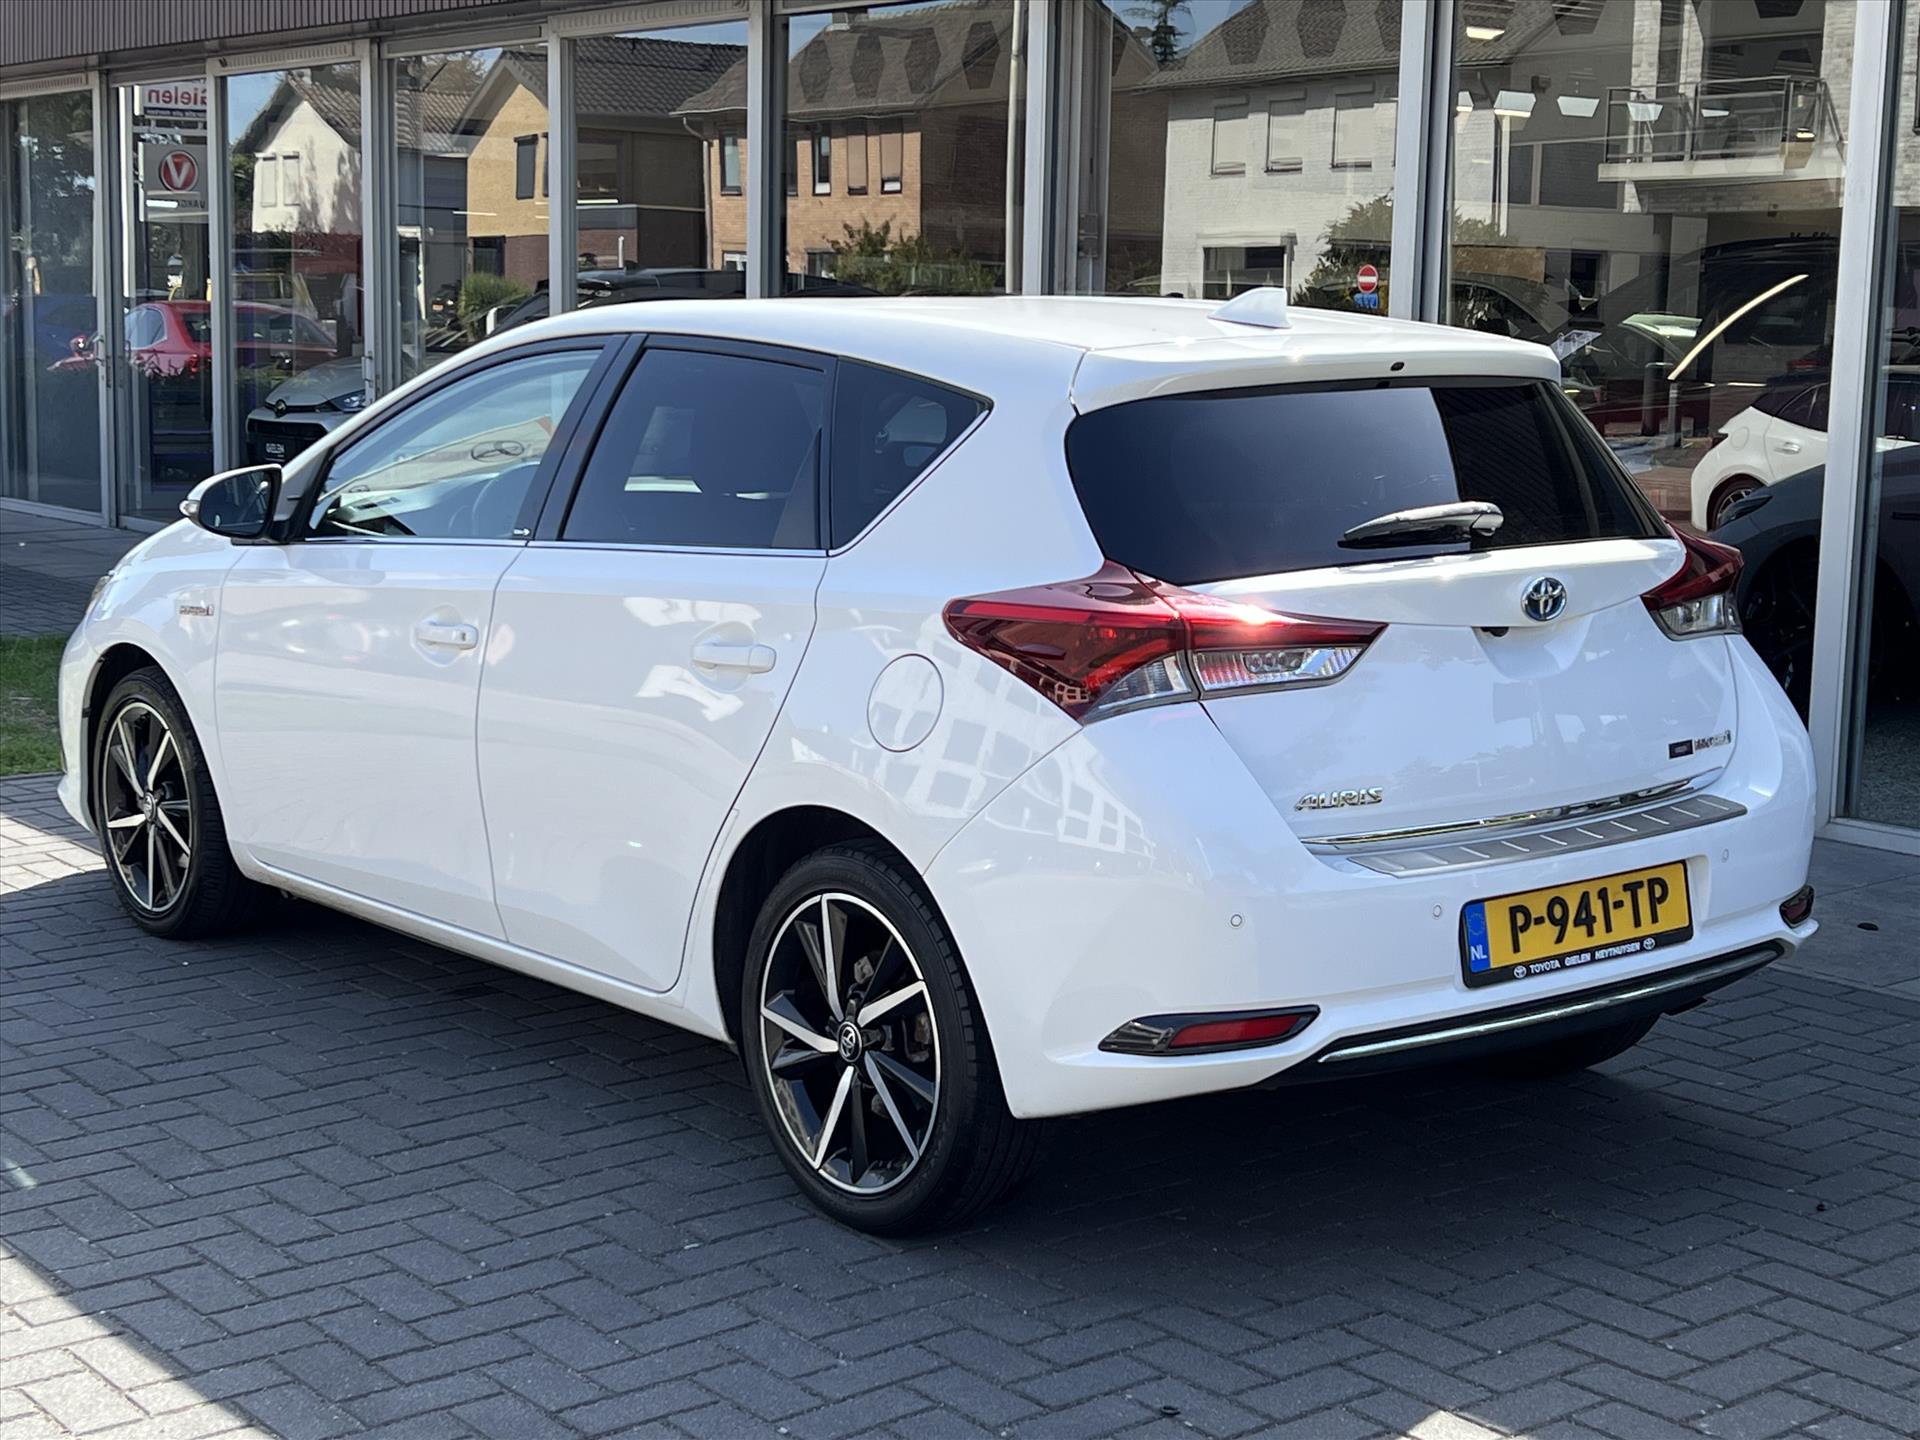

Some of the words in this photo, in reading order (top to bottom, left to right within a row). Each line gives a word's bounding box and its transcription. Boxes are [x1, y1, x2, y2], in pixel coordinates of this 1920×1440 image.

[1294, 787, 1383, 811] AURIS
[1508, 876, 1669, 954] P-941-TP
[1470, 943, 1488, 961] NL
[1529, 959, 1561, 975] TOYOTA
[1564, 952, 1591, 967] GIELEN
